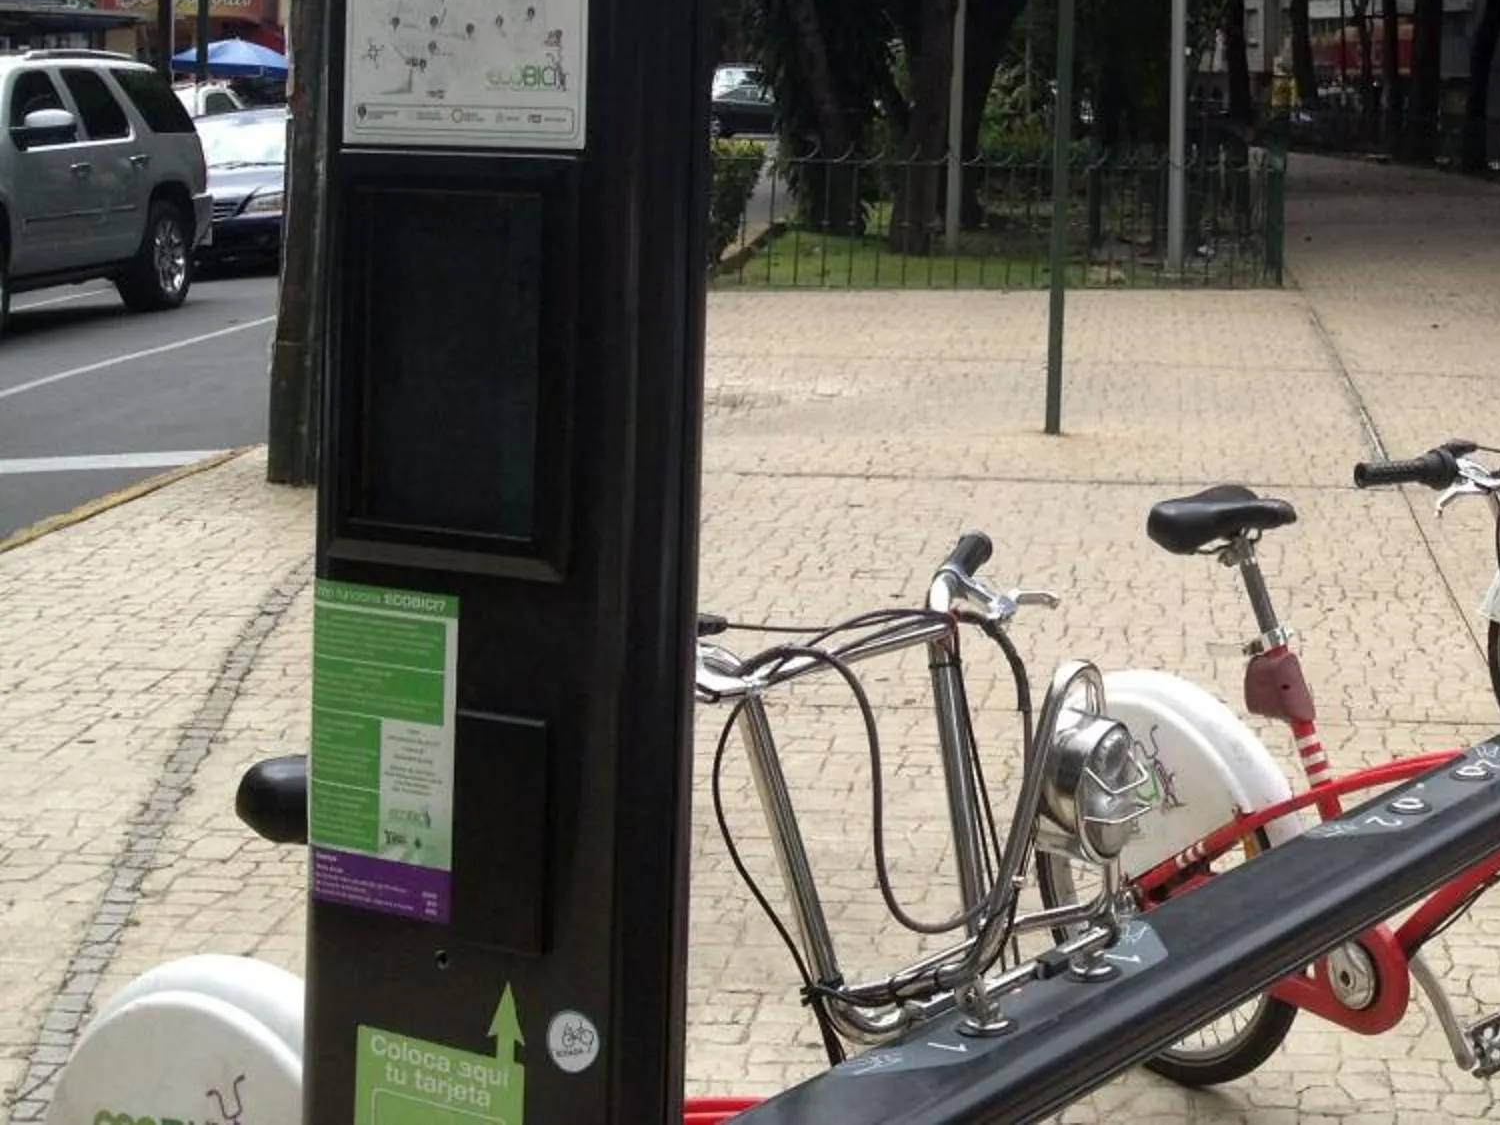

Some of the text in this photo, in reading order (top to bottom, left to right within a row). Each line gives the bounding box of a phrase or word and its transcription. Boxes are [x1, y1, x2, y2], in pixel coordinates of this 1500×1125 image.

[370, 1034, 451, 1074] Coloca
[385, 1061, 492, 1108] tu tarjeta
